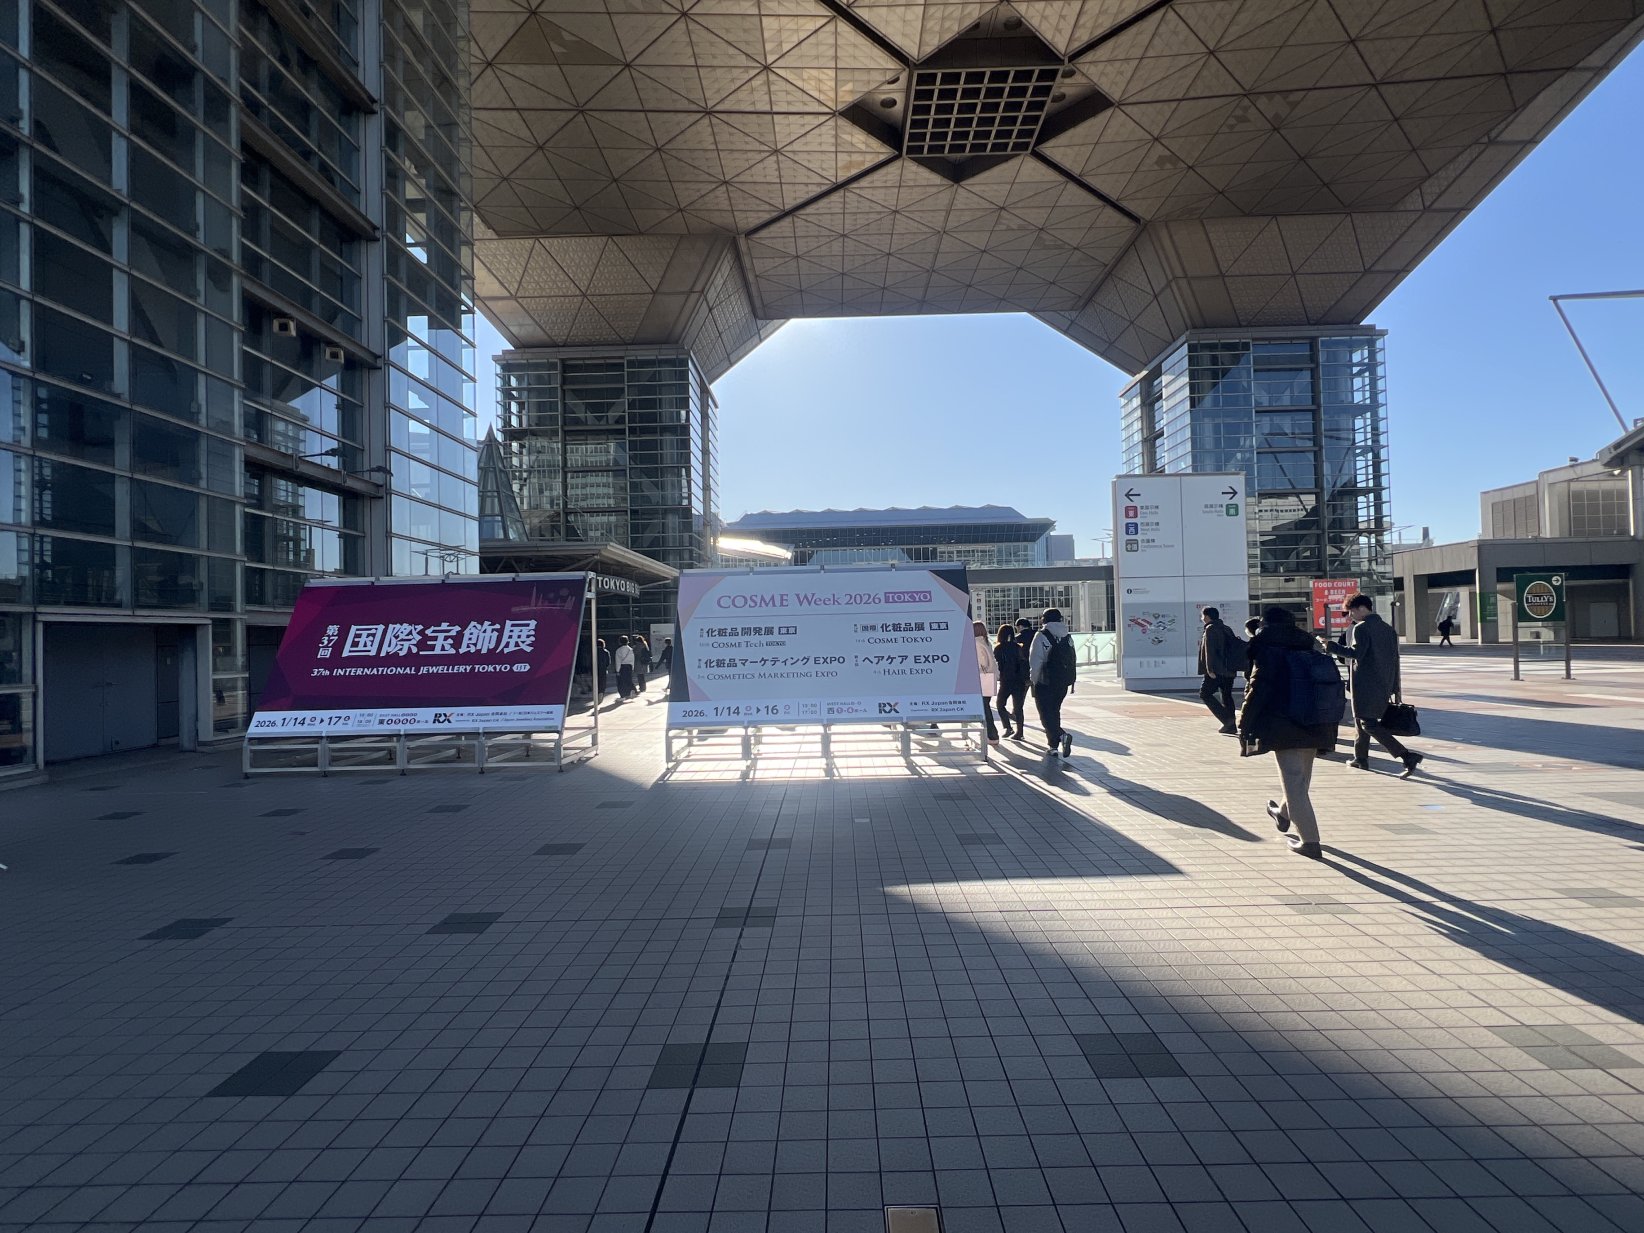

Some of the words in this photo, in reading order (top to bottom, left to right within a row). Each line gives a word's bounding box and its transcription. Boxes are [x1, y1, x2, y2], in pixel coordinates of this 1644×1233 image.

[596, 576, 626, 592] TOKYO
[626, 581, 635, 593] BIG
[716, 593, 789, 609] COSME
[794, 592, 843, 606] Week
[844, 593, 882, 606] 2026
[885, 591, 932, 603] TOKYO
[706, 626, 774, 638] 化粧品開発展
[880, 621, 925, 633] 化粧品展
[341, 619, 538, 658] 国際宝飾展
[711, 641, 742, 649] COSME
[743, 640, 764, 648] Tech
[900, 636, 933, 644] TOKYO
[704, 655, 811, 669] 化粧品マーケティング
[813, 656, 846, 665] EXPO
[862, 654, 908, 665] ヘアケア
[914, 654, 950, 664] EXPO
[310, 668, 330, 677] 37th
[332, 666, 416, 676] INTERNATIONAL
[418, 664, 473, 675] JEWELLERY
[474, 663, 510, 673] TOKYO
[706, 672, 755, 681] COSMETICS
[758, 671, 813, 680] MARKETING
[815, 670, 838, 678] EXPO
[883, 668, 907, 676] HAIR
[909, 667, 933, 675] EXPO
[682, 709, 708, 718] 2026.
[713, 706, 741, 717] 1/14
[764, 704, 779, 716] 16
[878, 702, 900, 714] RX
[254, 720, 278, 728] 2026.
[280, 716, 306, 727] 1/14
[327, 716, 342, 726] 17
[432, 712, 455, 724] RX
